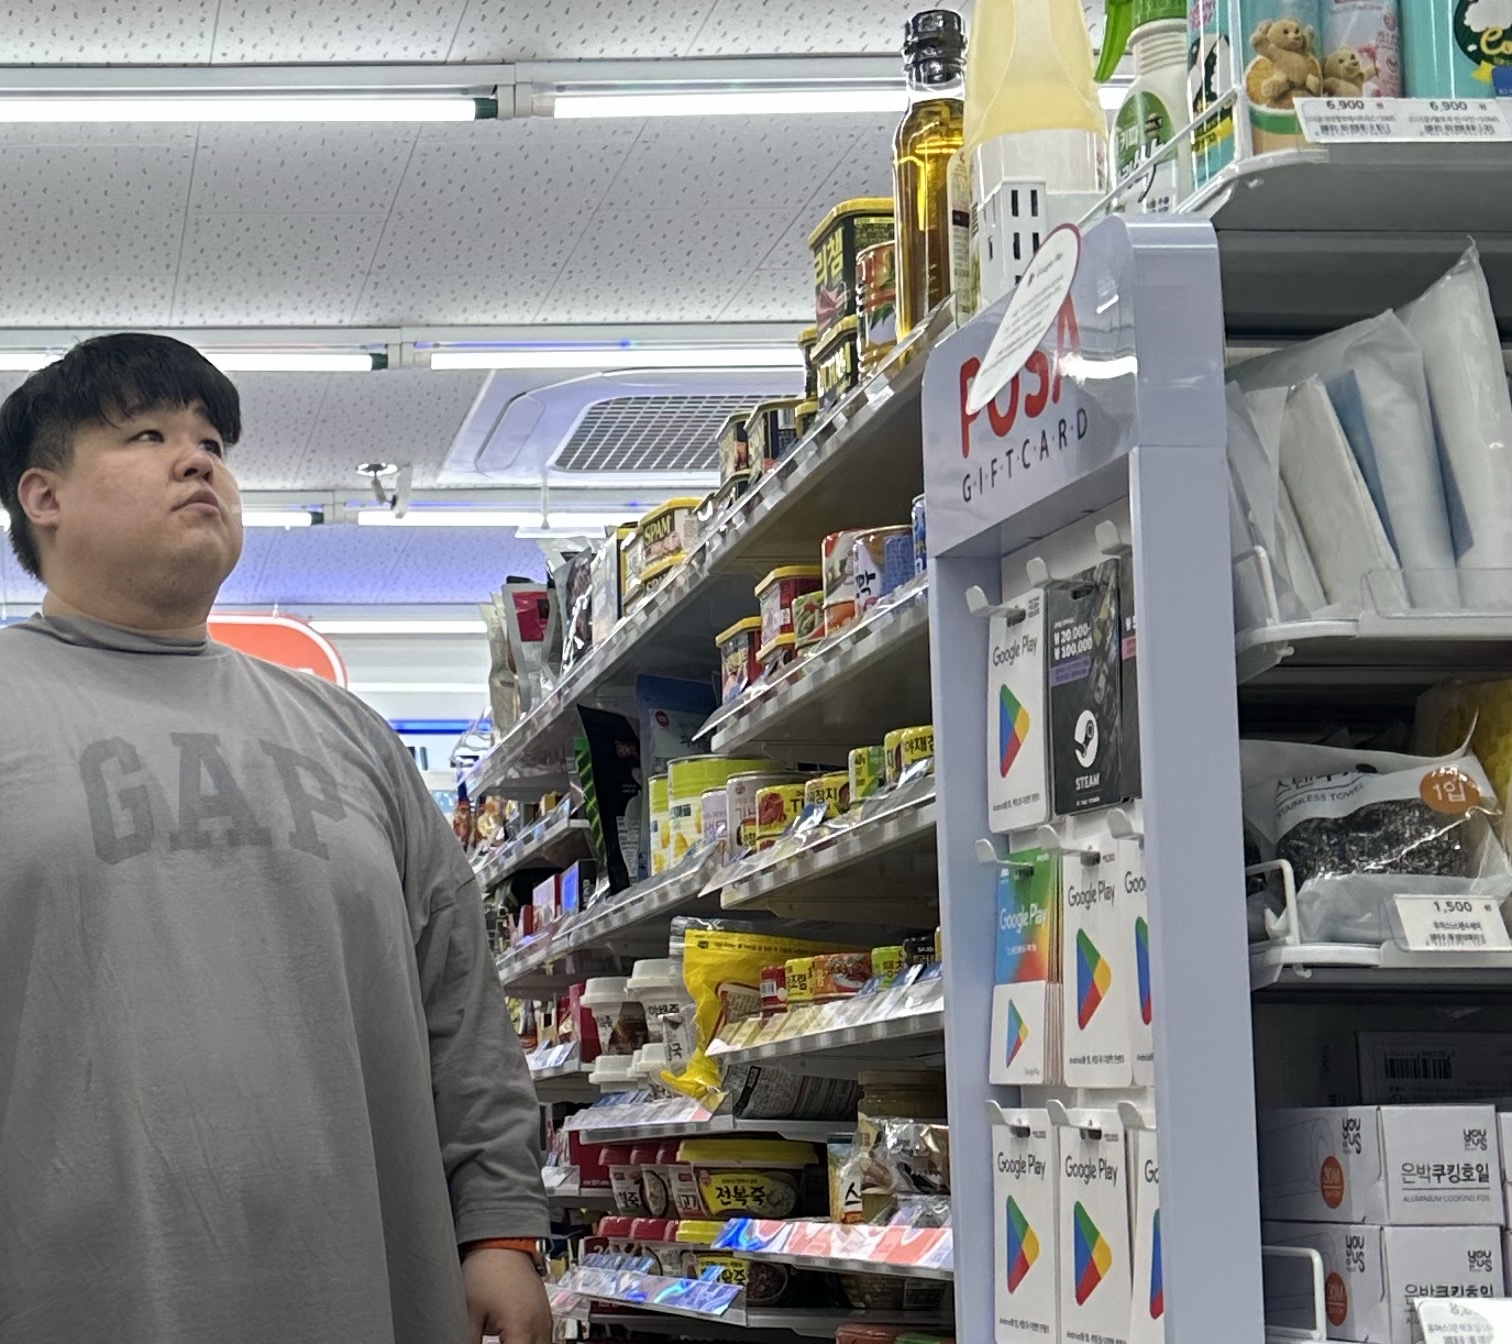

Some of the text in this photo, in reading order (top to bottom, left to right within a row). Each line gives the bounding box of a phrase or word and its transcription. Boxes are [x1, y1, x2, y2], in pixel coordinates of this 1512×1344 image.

[991, 634, 1039, 666] Google Play
[1074, 772, 1101, 792] STEAM
[78, 731, 349, 867] GAP
[1067, 880, 1115, 910] Google Play
[1123, 870, 1147, 895] Goo
[999, 902, 1048, 934] Google Play
[1432, 900, 1473, 913] 1,500
[997, 1150, 1046, 1180] Google Play
[1064, 1154, 1098, 1185] Google
[1098, 1157, 1119, 1187] Play
[1401, 1162, 1490, 1184] 은박쿠킹호일
[715, 1184, 767, 1207] 전복죽
